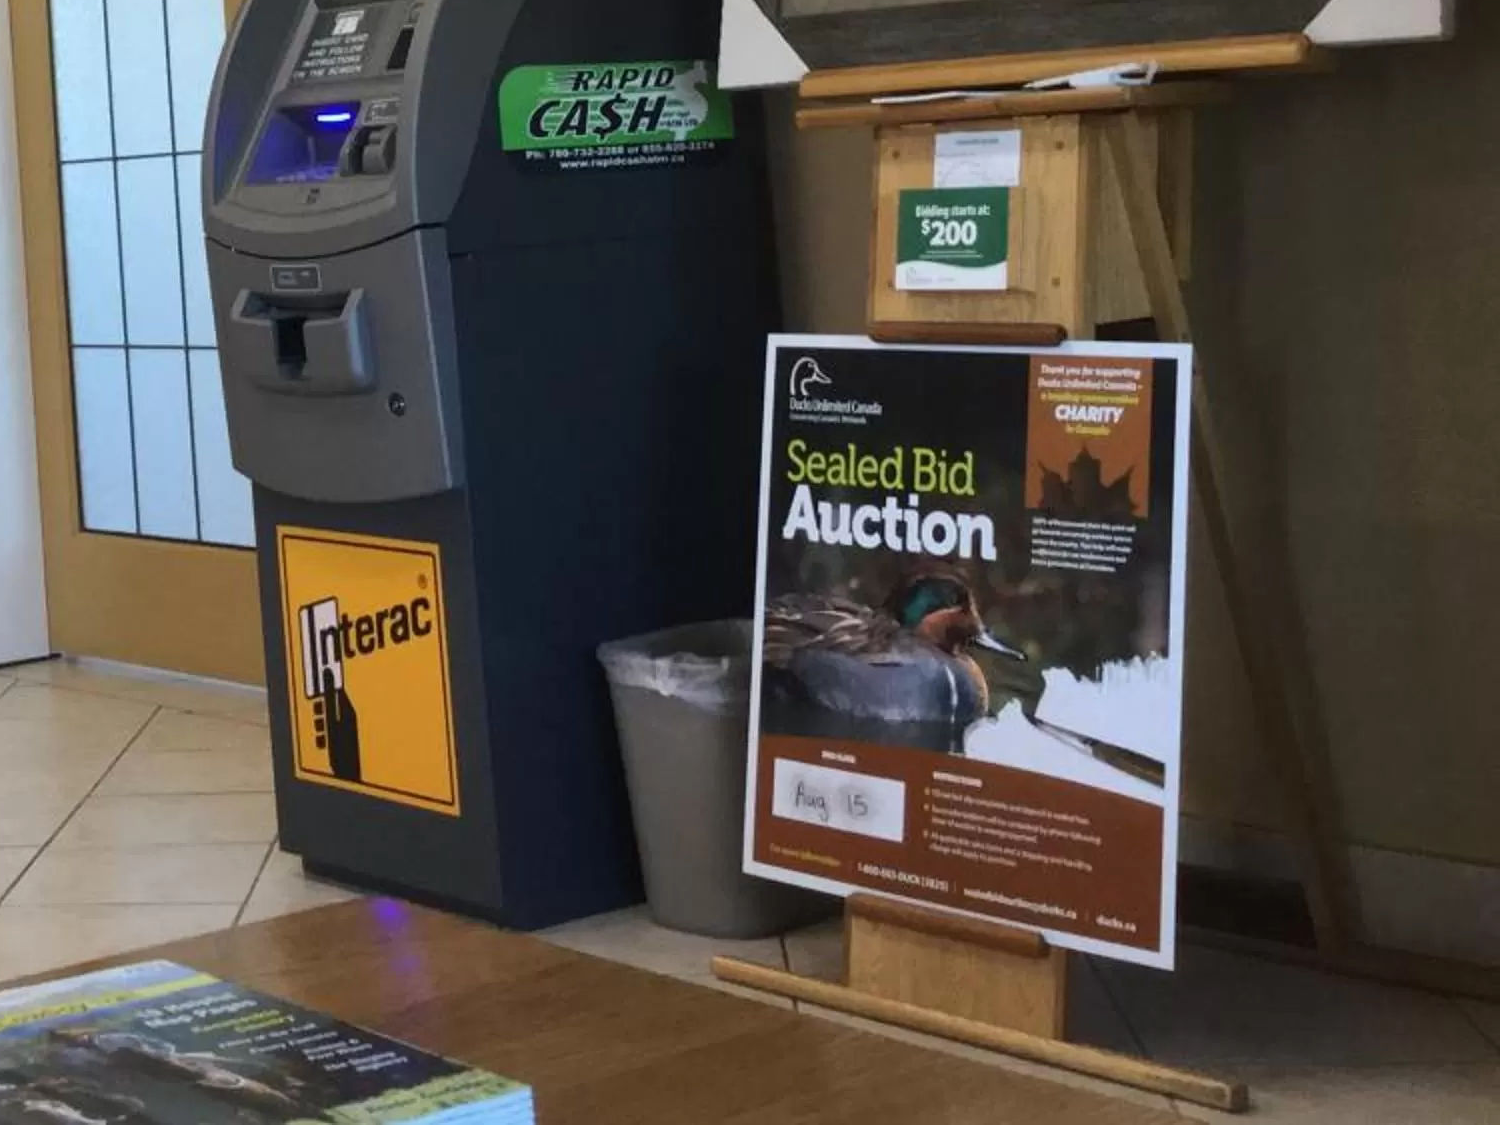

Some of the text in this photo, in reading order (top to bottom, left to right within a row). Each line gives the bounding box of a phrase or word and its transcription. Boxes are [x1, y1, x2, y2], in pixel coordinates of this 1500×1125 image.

[572, 67, 675, 92] RAPID
[528, 93, 667, 139] CA$H
[915, 204, 949, 219] Bidding
[921, 219, 978, 246] $200
[1055, 404, 1124, 423] CHARITY
[787, 439, 975, 496] Sealed Bid
[783, 484, 997, 561] Auction
[307, 595, 433, 699] Interac
[794, 779, 869, 822] Aug 15
